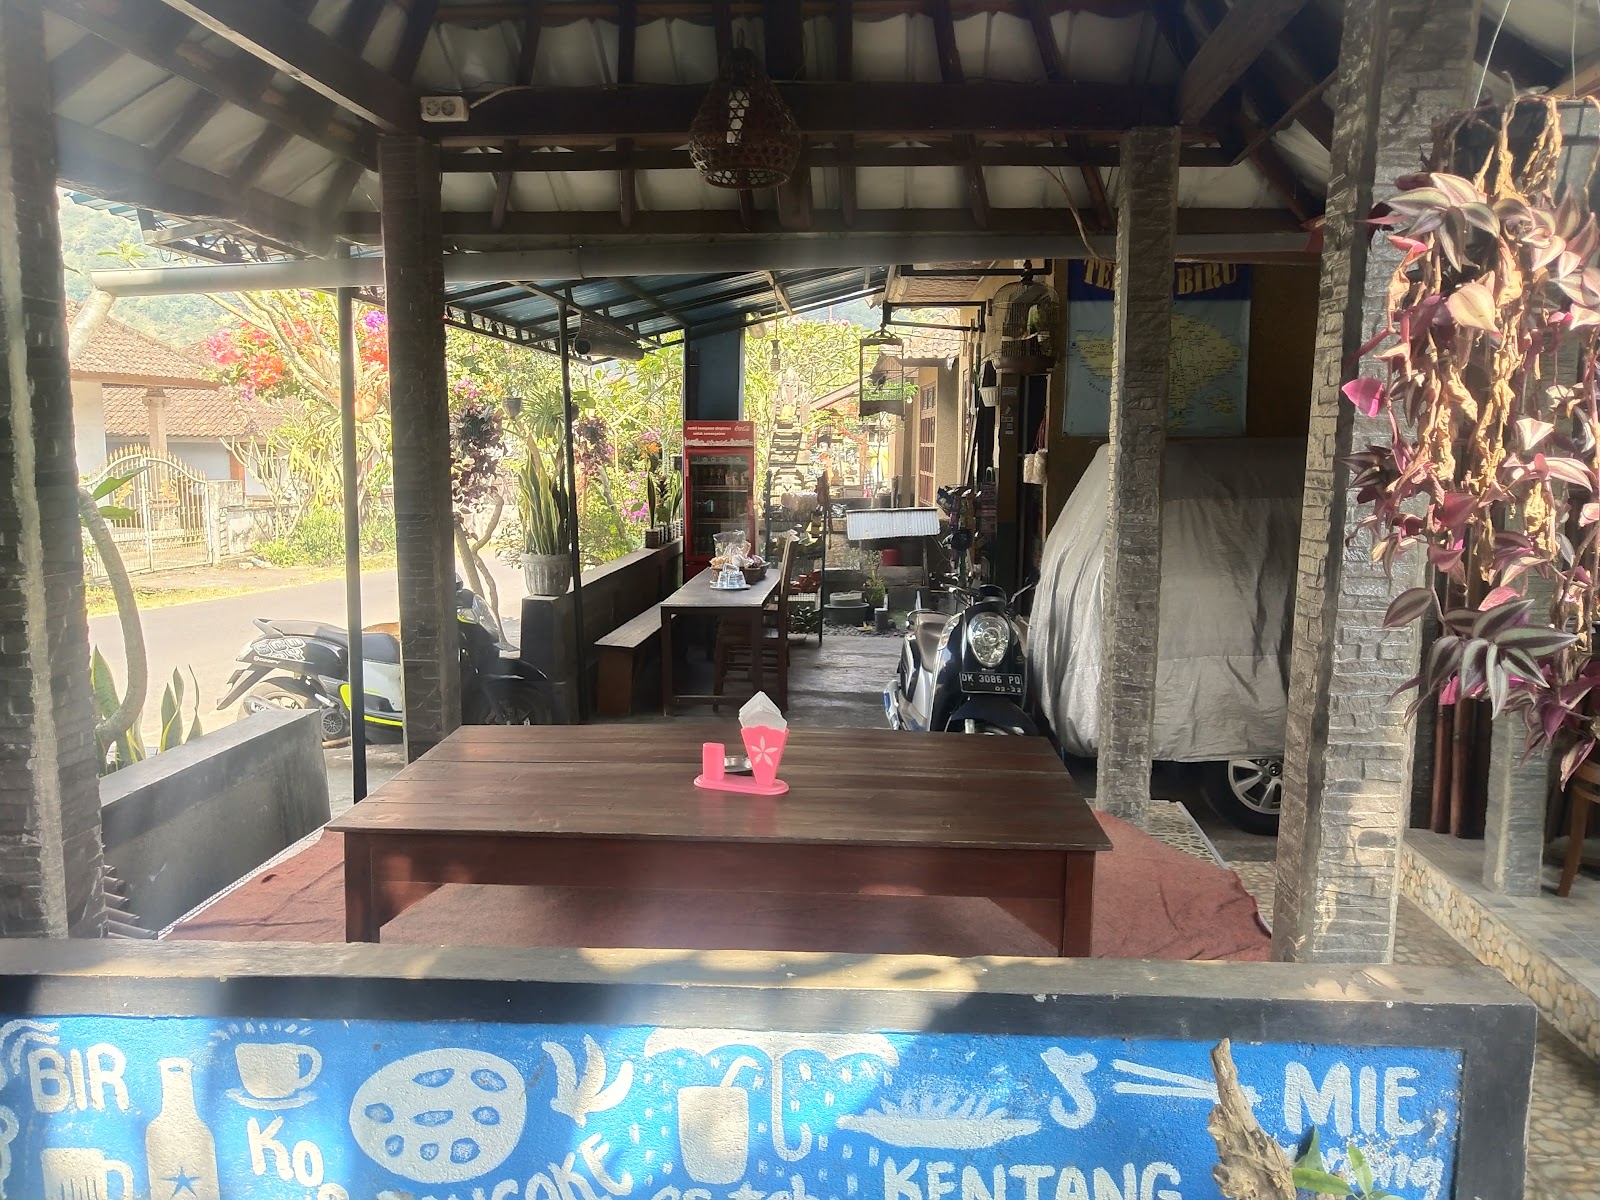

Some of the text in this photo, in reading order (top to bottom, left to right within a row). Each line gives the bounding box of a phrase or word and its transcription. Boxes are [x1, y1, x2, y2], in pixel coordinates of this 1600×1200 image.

[1177, 263, 1237, 295] BIRU
[961, 673, 974, 683] DK
[979, 674, 1002, 684] 3086
[28, 1043, 129, 1113] BIR
[1284, 1061, 1426, 1138] MIE
[883, 1157, 1183, 1200] KENTANG
